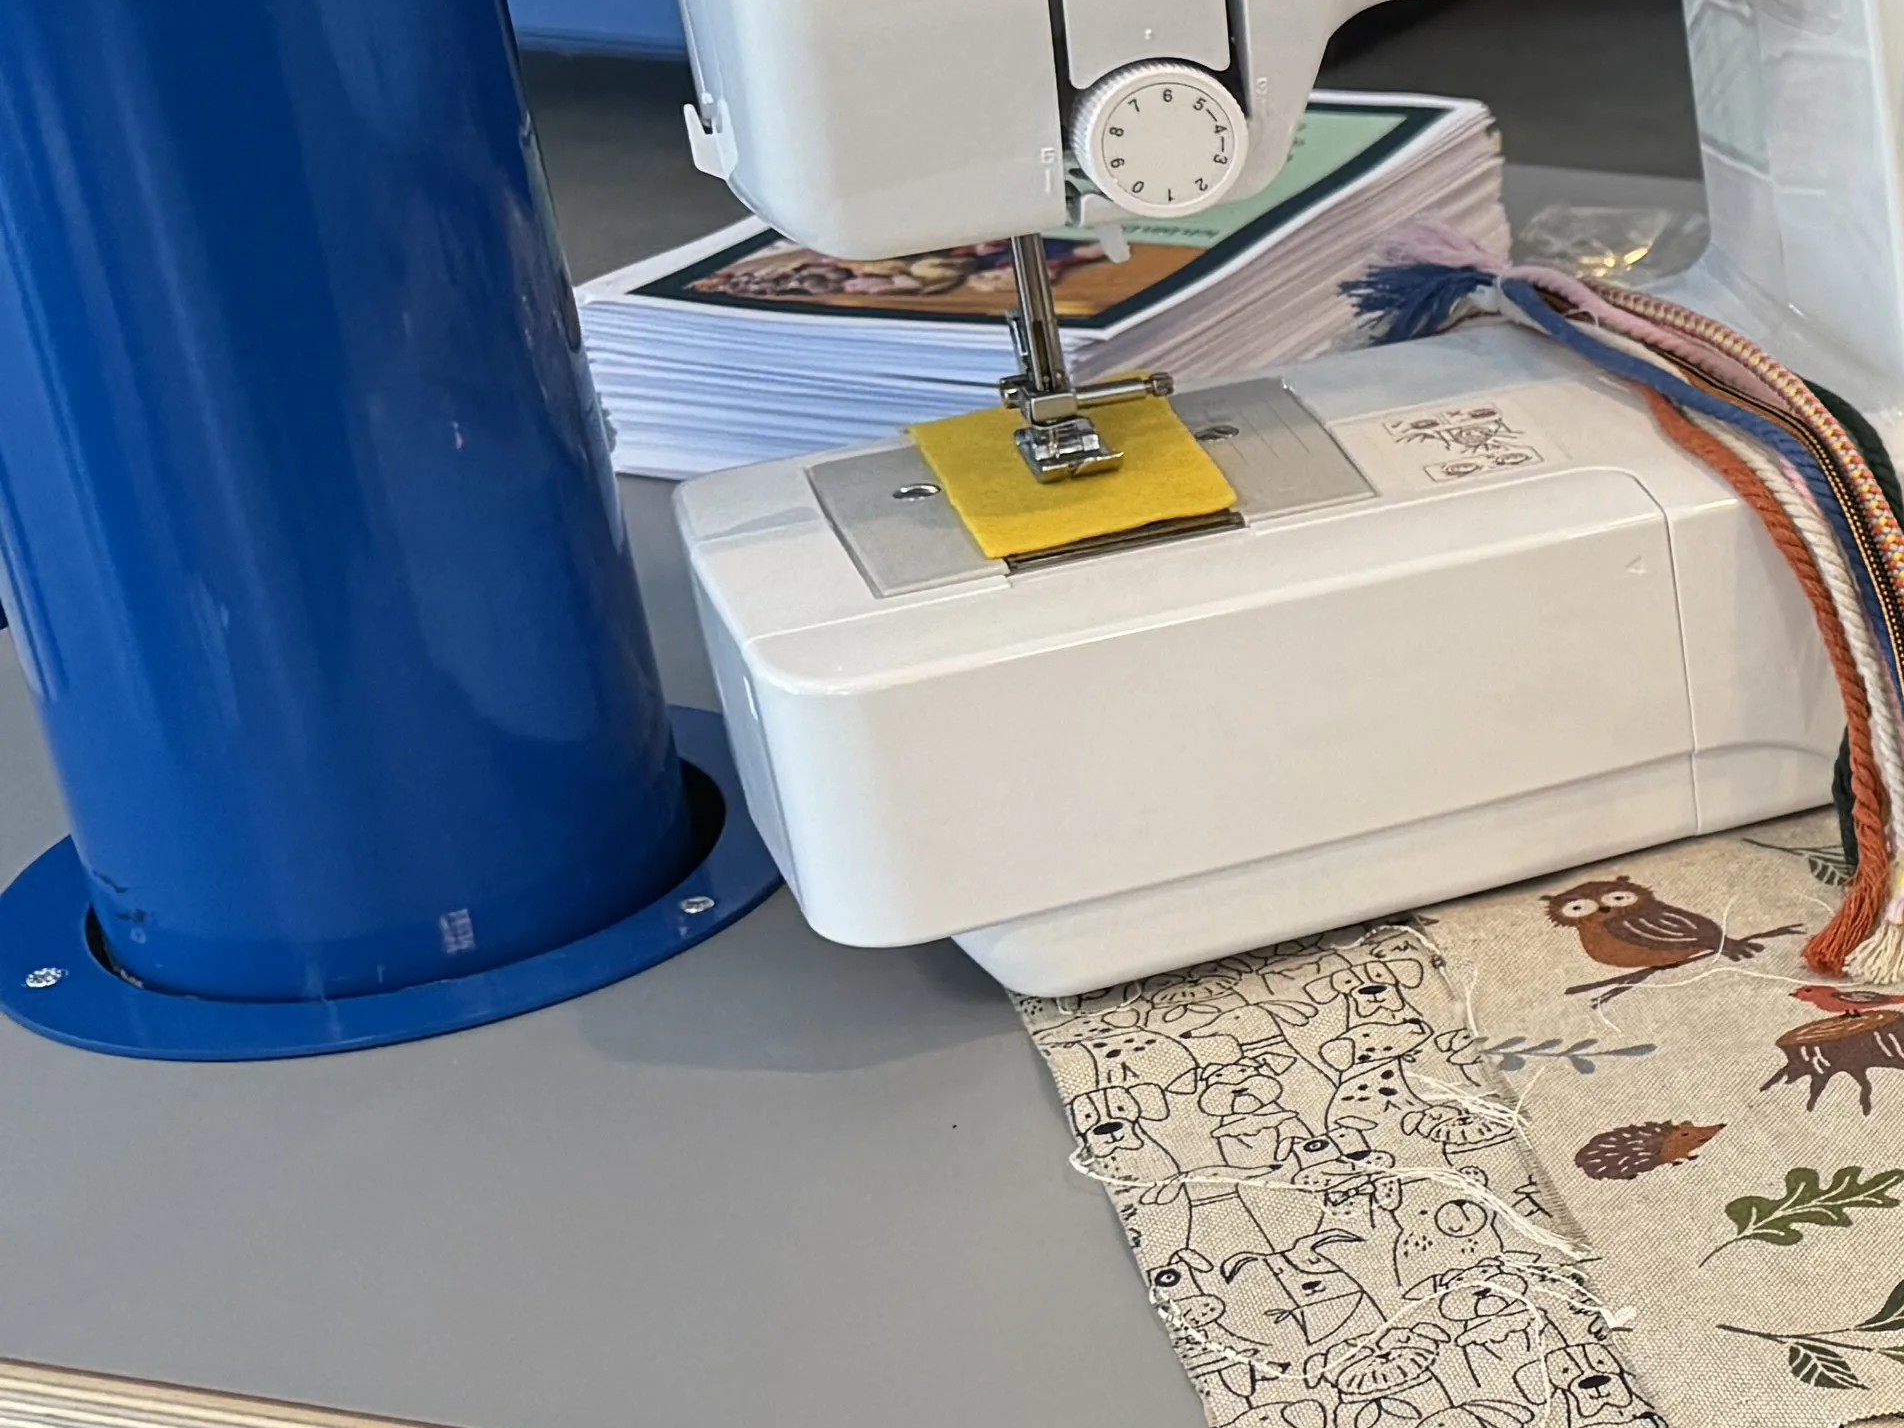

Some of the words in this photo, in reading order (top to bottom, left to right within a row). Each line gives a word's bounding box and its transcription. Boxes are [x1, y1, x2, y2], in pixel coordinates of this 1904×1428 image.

[1162, 89, 1173, 103] 6
[1127, 98, 1141, 113] 7
[1193, 97, 1207, 112] 5
[1108, 126, 1125, 138] 8
[1213, 124, 1228, 135] 4
[1110, 157, 1125, 169] 9
[1213, 154, 1228, 166] 3
[1131, 180, 1145, 194] 0
[1194, 177, 1208, 192] 2
[1167, 188, 1175, 203] 1
